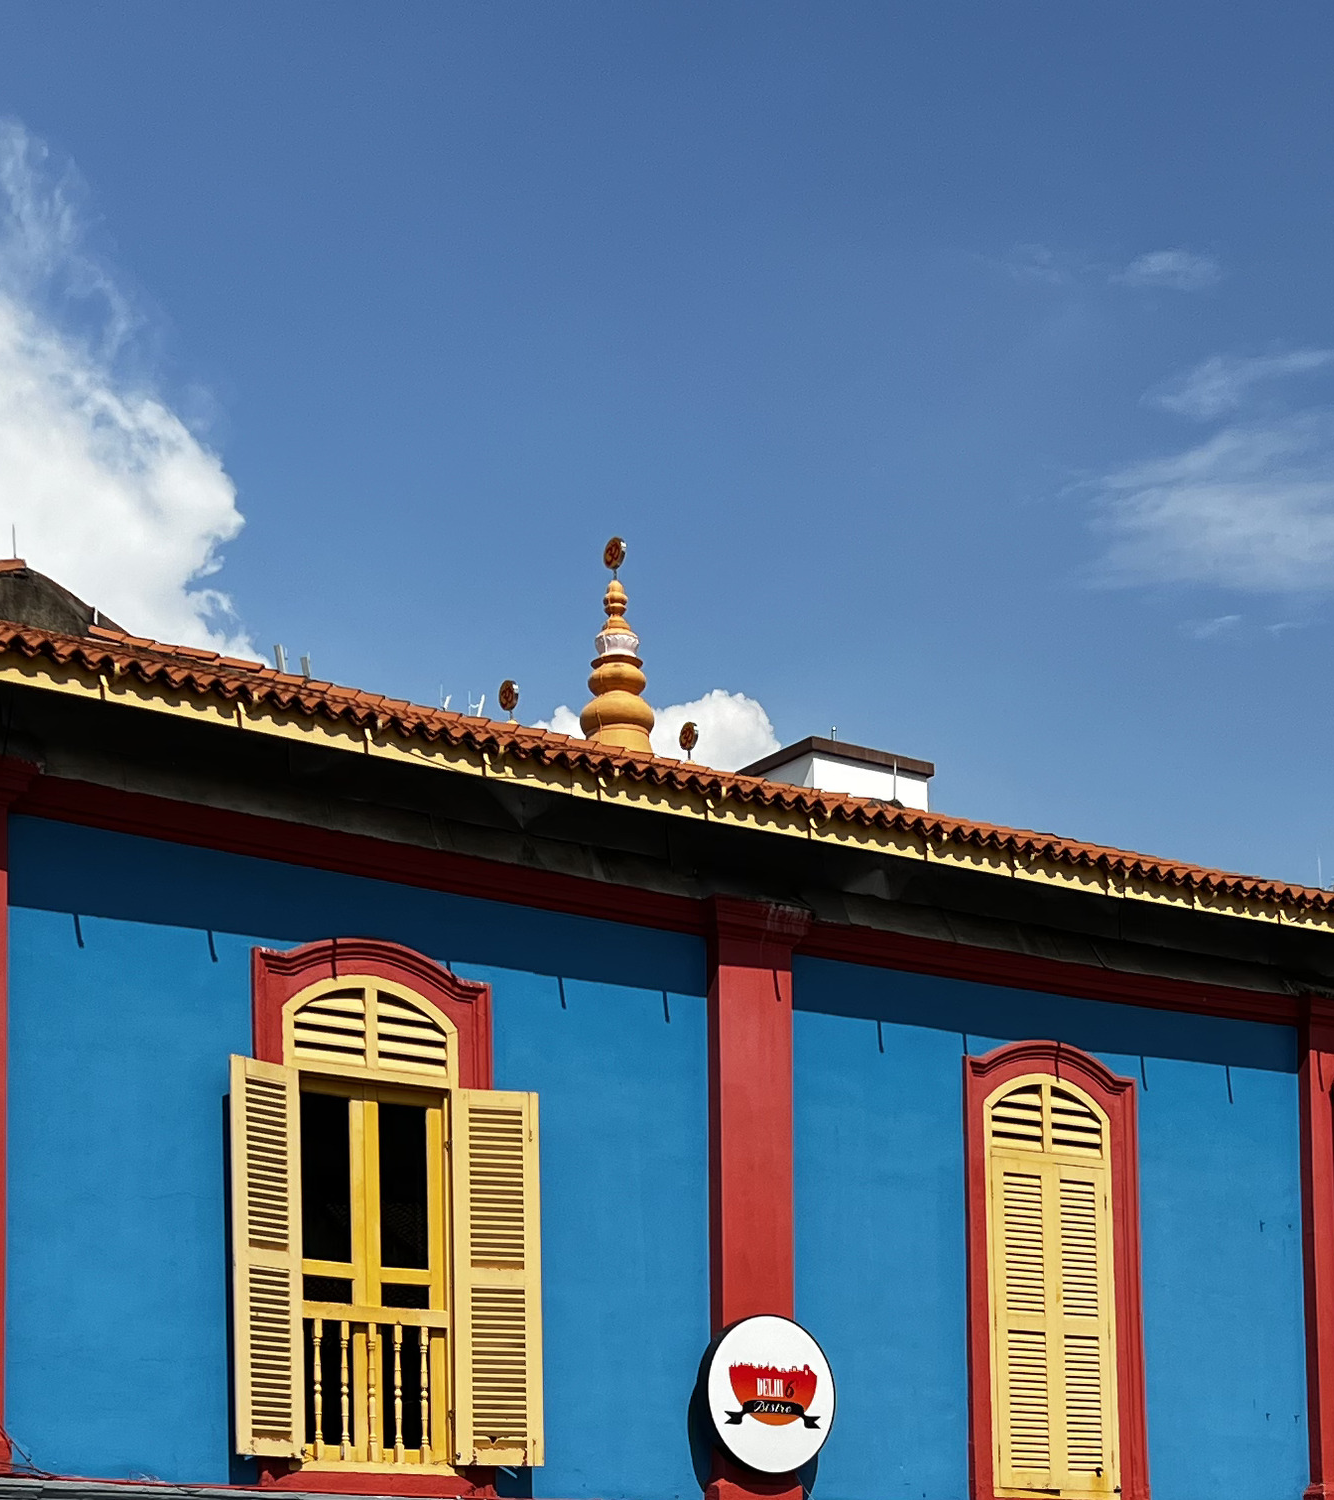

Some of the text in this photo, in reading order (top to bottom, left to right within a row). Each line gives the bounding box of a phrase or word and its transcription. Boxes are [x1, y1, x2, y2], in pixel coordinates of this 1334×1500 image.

[756, 1377, 796, 1399] DELHI 6
[753, 1400, 792, 1414] Bistro
